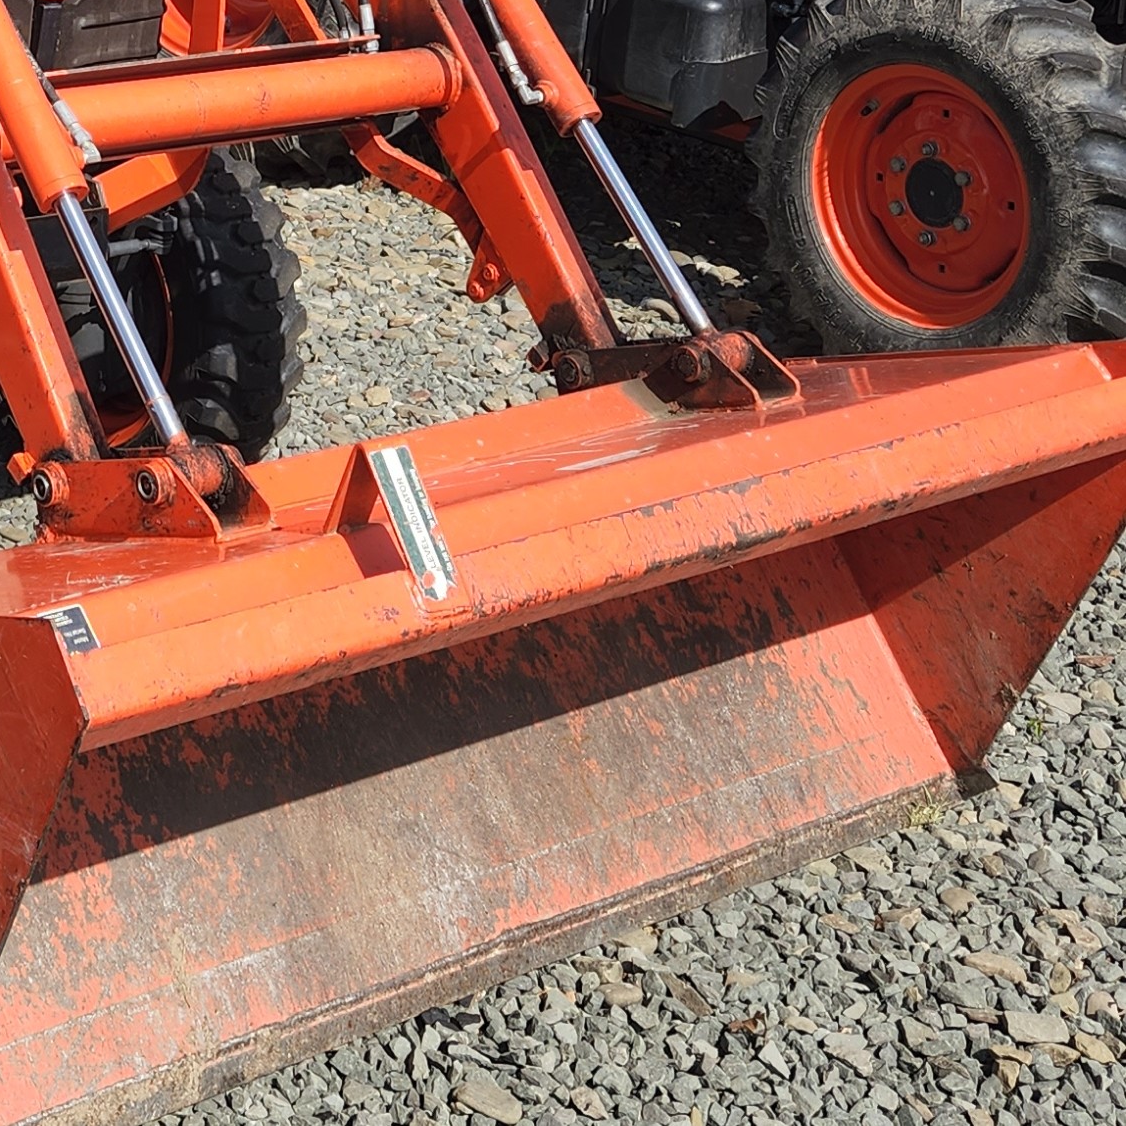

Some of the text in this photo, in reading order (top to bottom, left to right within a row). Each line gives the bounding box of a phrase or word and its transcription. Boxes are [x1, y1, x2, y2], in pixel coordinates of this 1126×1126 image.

[921, 24, 1029, 111] HI-TRACTION
[396, 477, 424, 534] INDICATOR
[421, 537, 438, 570] LEVEL
